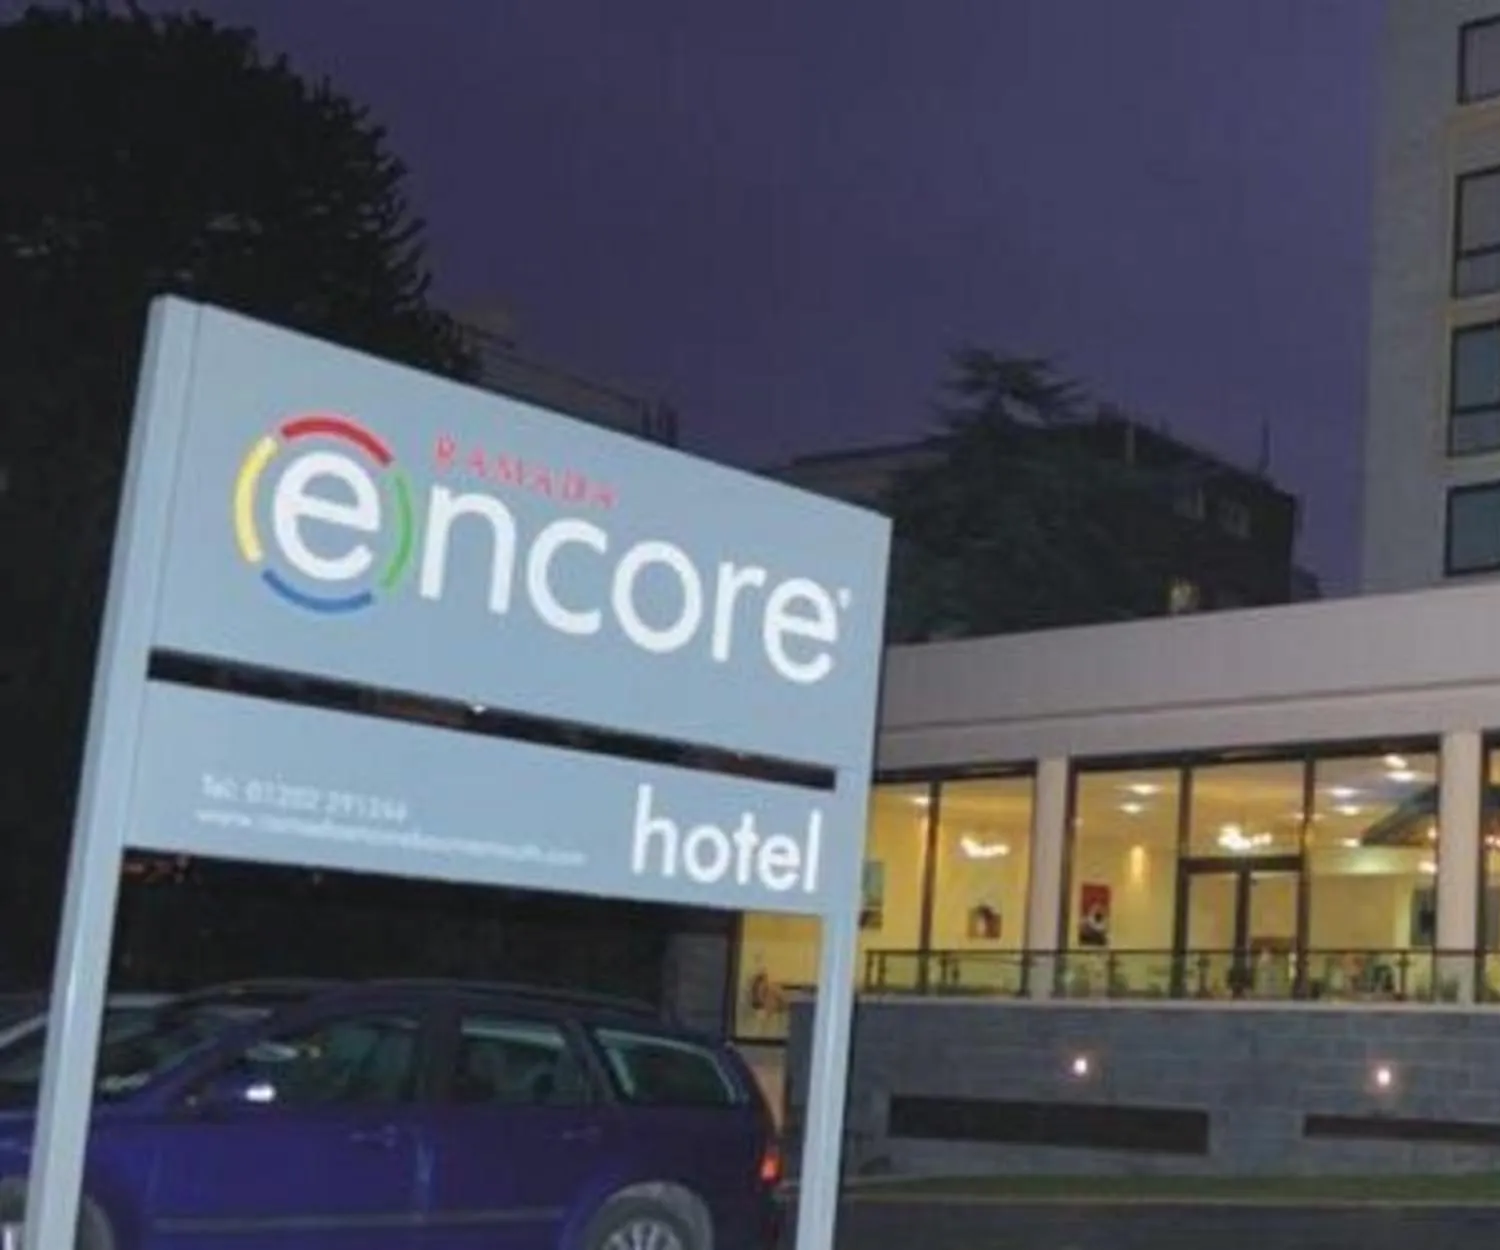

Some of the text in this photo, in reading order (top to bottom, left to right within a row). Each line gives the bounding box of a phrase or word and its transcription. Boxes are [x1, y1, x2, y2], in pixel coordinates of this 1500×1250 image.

[435, 433, 619, 509] RAMADA
[272, 451, 839, 684] encore
[631, 783, 823, 893] hotel
